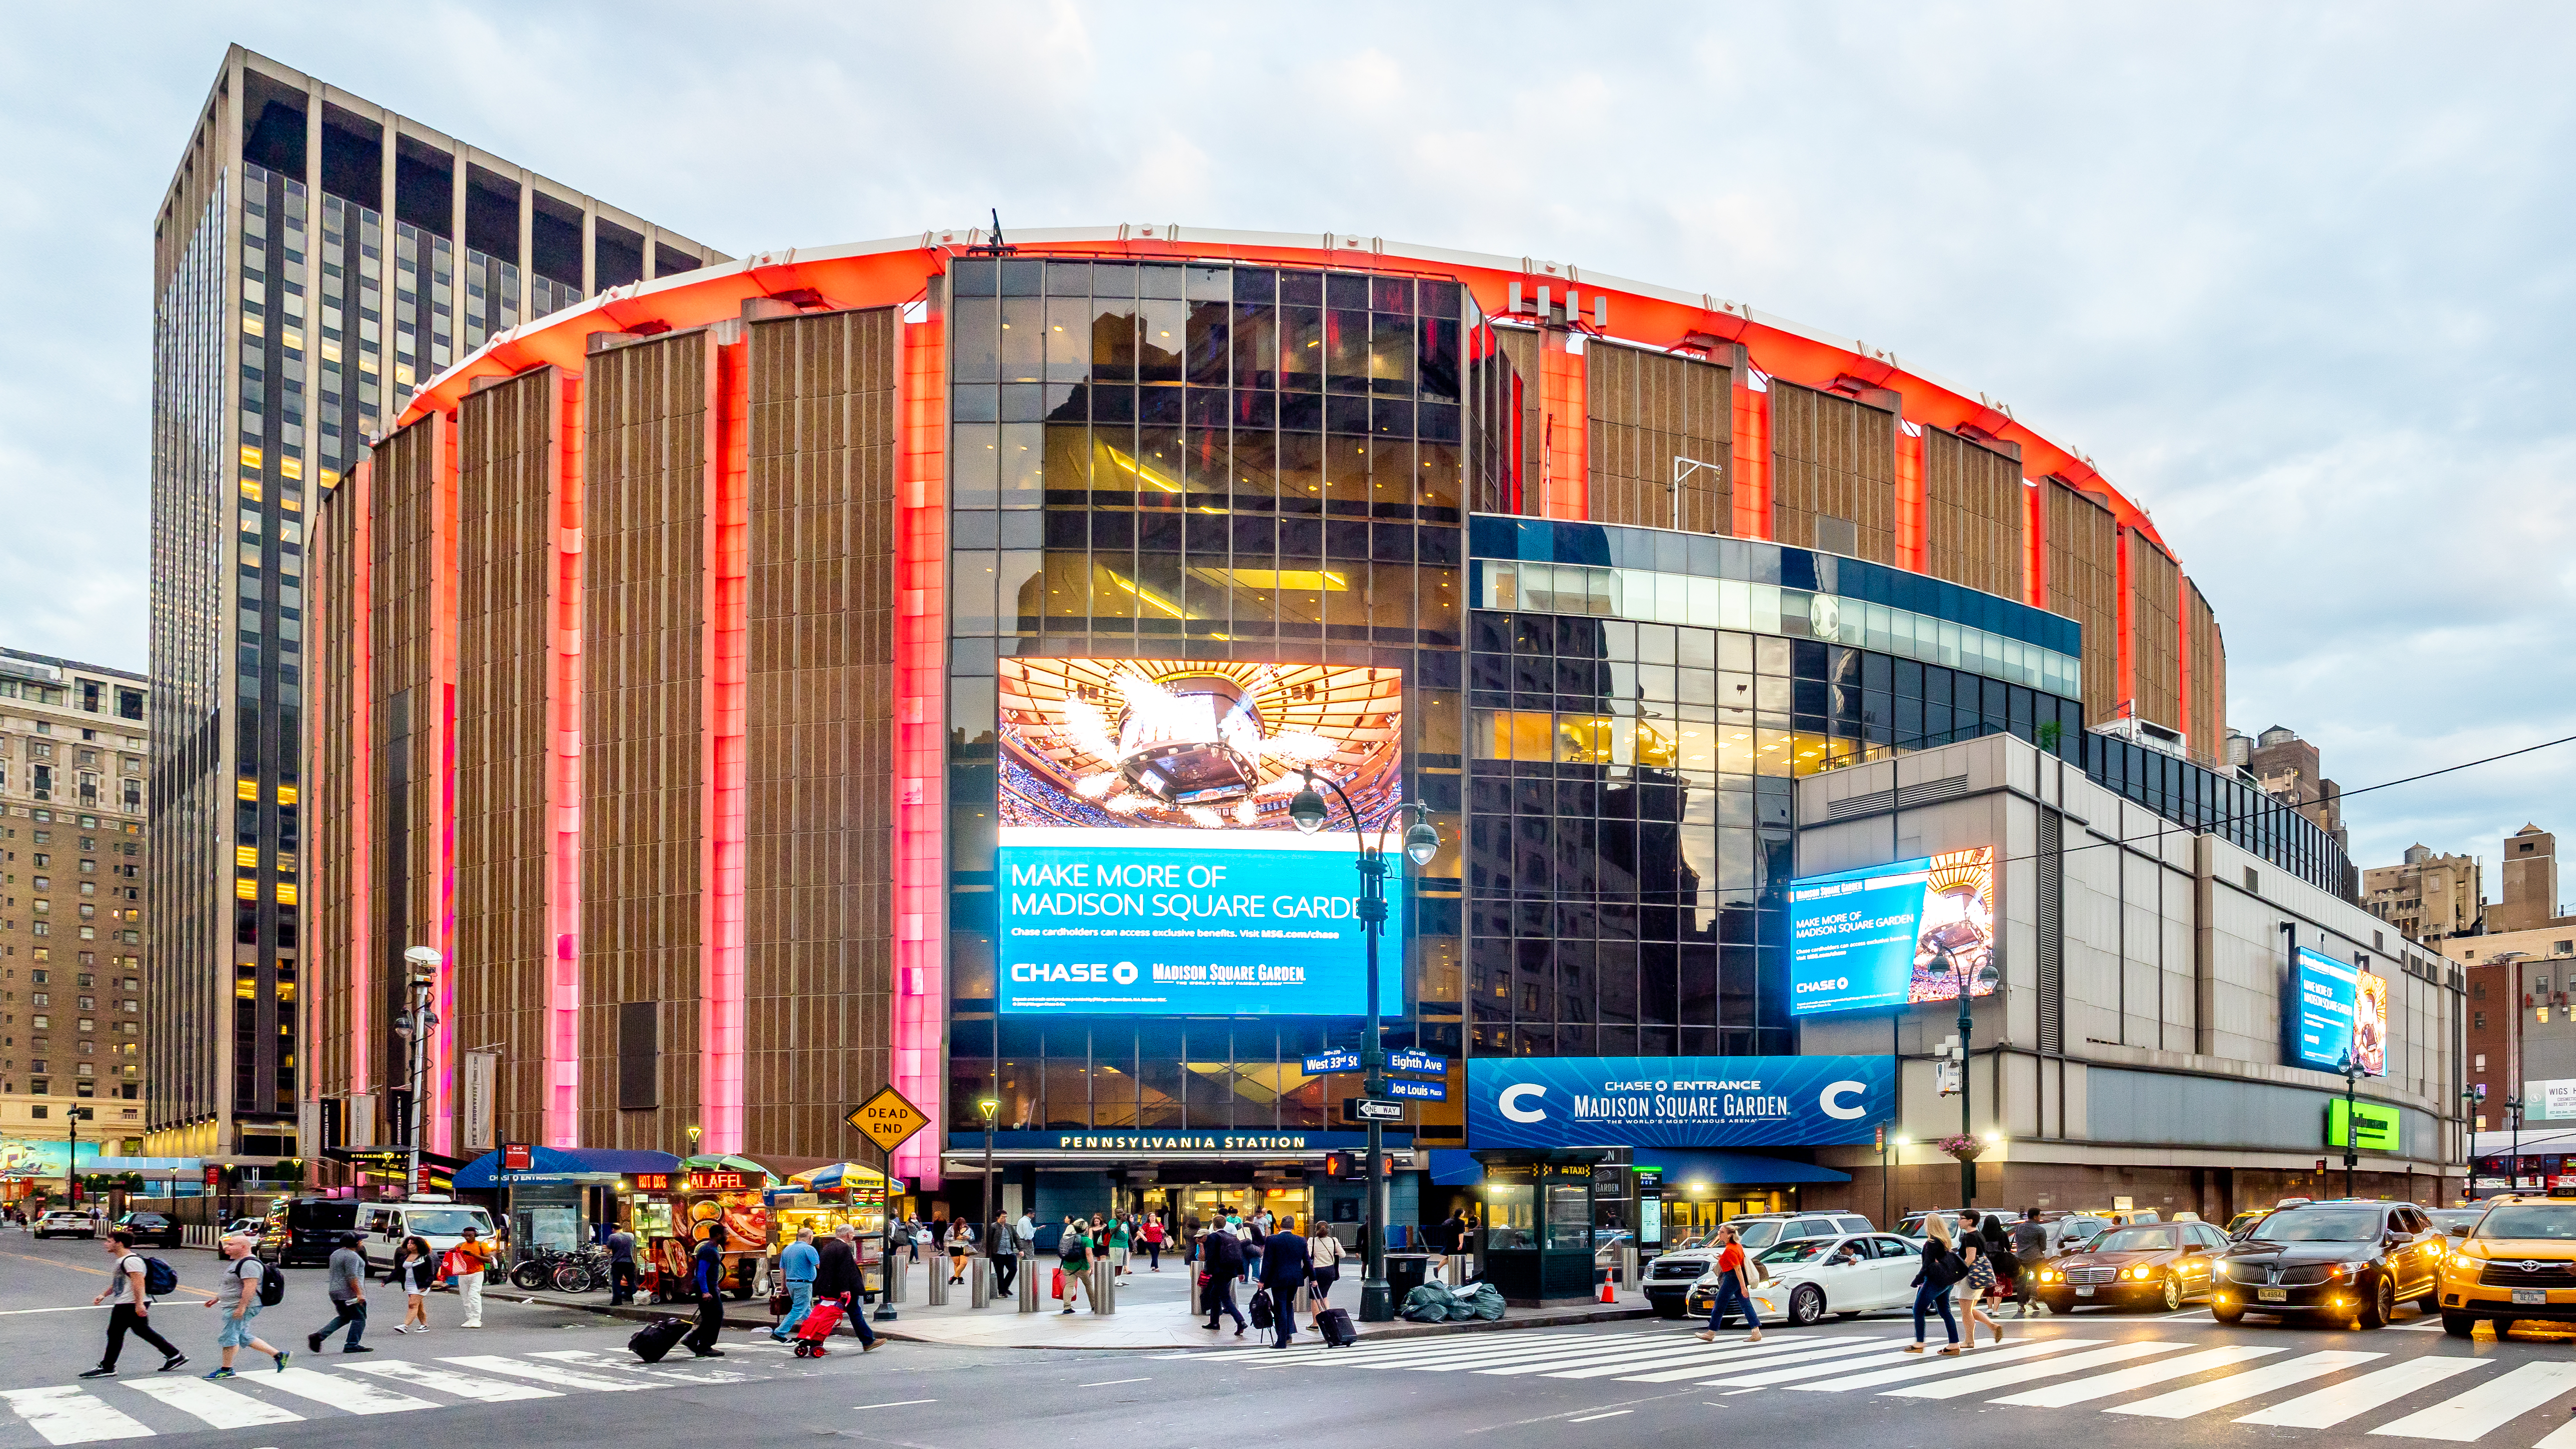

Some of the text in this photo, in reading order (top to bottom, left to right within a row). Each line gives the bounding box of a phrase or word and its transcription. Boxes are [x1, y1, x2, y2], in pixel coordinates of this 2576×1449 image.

[1012, 863, 1227, 888] MAKE MORE OF
[1796, 888, 1820, 900] MADISON
[1820, 885, 1840, 896] SQUARE
[1012, 893, 1144, 916] MADISON
[1152, 893, 1265, 921] SQUARE
[1796, 911, 1862, 929] MAKE MORE OF
[1796, 913, 1914, 938] MADISON SQUARE GARDEN
[1011, 927, 1041, 936] Chase
[1042, 927, 1099, 936] cardholders
[1152, 929, 1195, 937] exclusive
[1197, 929, 1238, 938] benefits.
[1240, 929, 1260, 938] Visit
[1261, 930, 1340, 939] MSG.com/chase
[1011, 963, 1108, 982] CHASE
[1153, 963, 1207, 980] MADISON
[1209, 963, 1255, 982] SQUARE
[1796, 979, 1836, 993] CHASE
[1307, 1056, 1358, 1071] West 33rd St
[1392, 1055, 1442, 1071] Eighth Ave
[1392, 1083, 1406, 1094] Joe
[1407, 1084, 1428, 1096] Louis
[1605, 1081, 1761, 1091] CHASE ENTRANCE
[1499, 1083, 1547, 1123] C
[1574, 1095, 1649, 1117] MADISON
[1655, 1094, 1718, 1118] SQUARE
[1820, 1080, 1867, 1120] C
[868, 1108, 908, 1119] DEAD
[1364, 1105, 1397, 1114] ONE WAY
[874, 1123, 902, 1133] END
[1061, 1137, 1304, 1148] PENNSYLVANIA STATION
[1569, 1166, 1585, 1174] TAXI
[638, 1174, 667, 1189] HOT DOG
[1595, 1182, 1619, 1192] GARDEN
